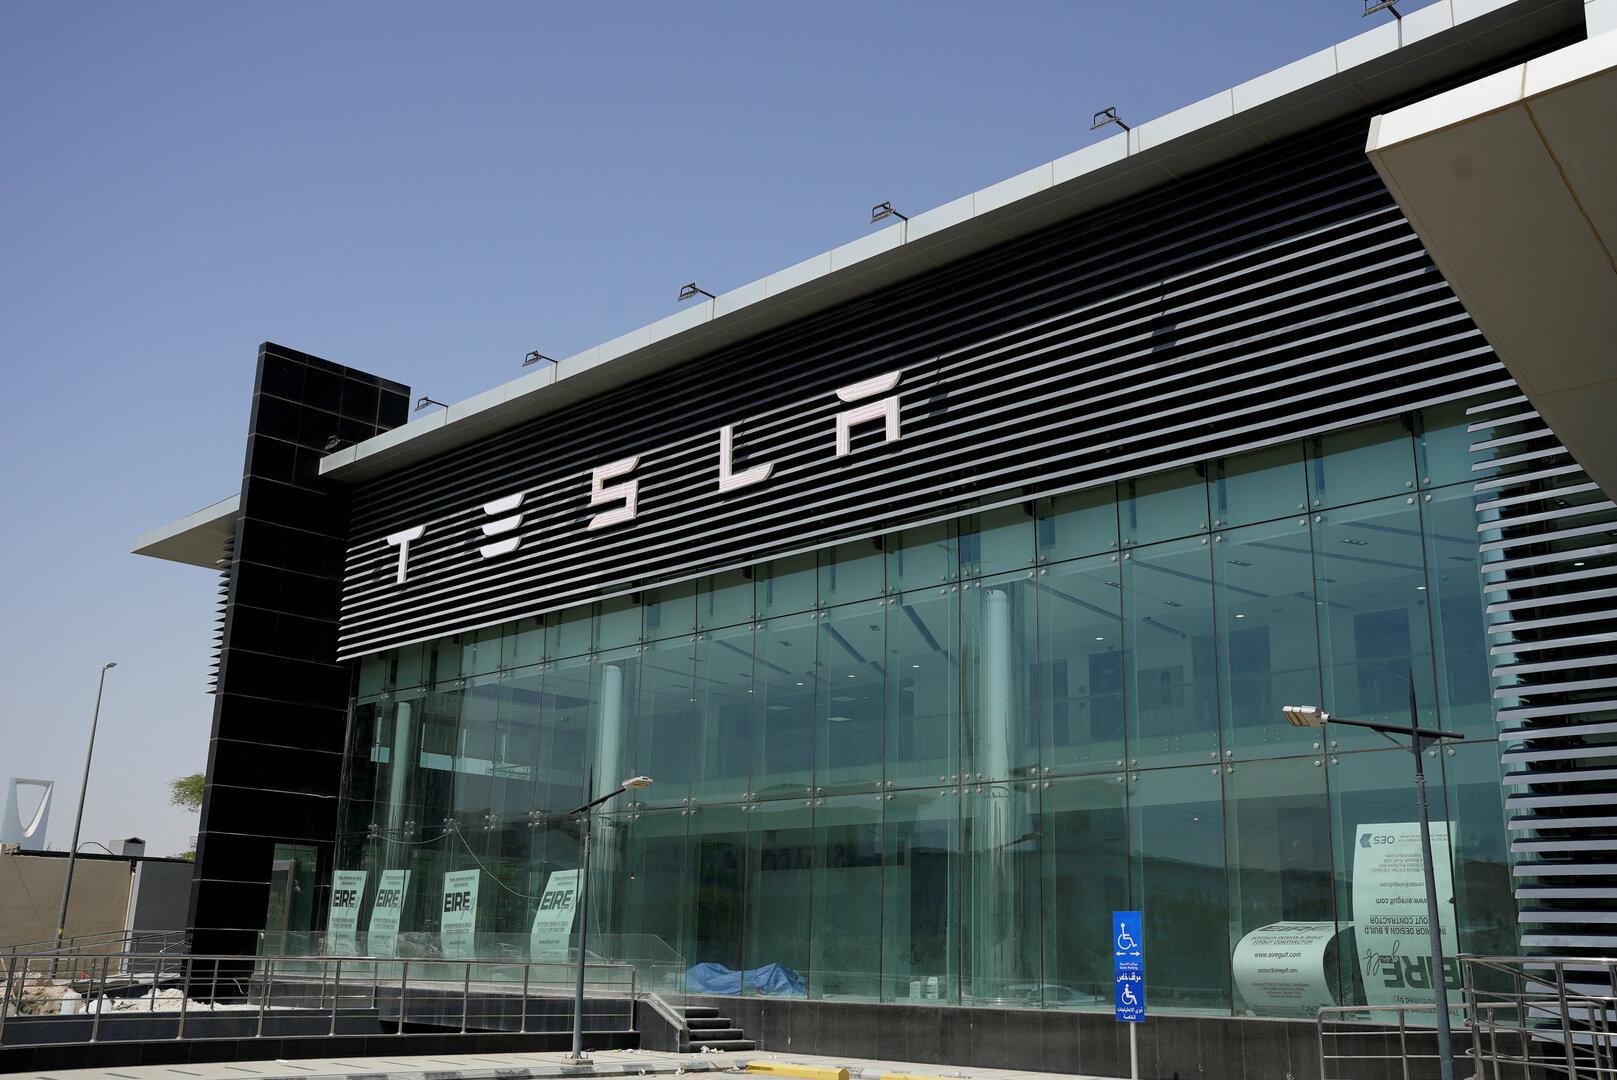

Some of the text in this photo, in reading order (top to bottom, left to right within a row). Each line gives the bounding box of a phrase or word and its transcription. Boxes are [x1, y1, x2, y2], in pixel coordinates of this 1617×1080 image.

[386, 370, 901, 584] TESLA
[1373, 836, 1395, 844] OES
[333, 889, 357, 908] EIRE
[376, 889, 401, 908] EIRE
[444, 891, 471, 912] EIRE
[540, 889, 574, 911] EIRE
[1370, 917, 1413, 925] CONTRACTOR
[1365, 927, 1384, 935] BUILD
[1392, 927, 1414, 935] DESIGN
[1254, 951, 1301, 959] www.eiregulf.com
[1381, 955, 1461, 990] EIRE
